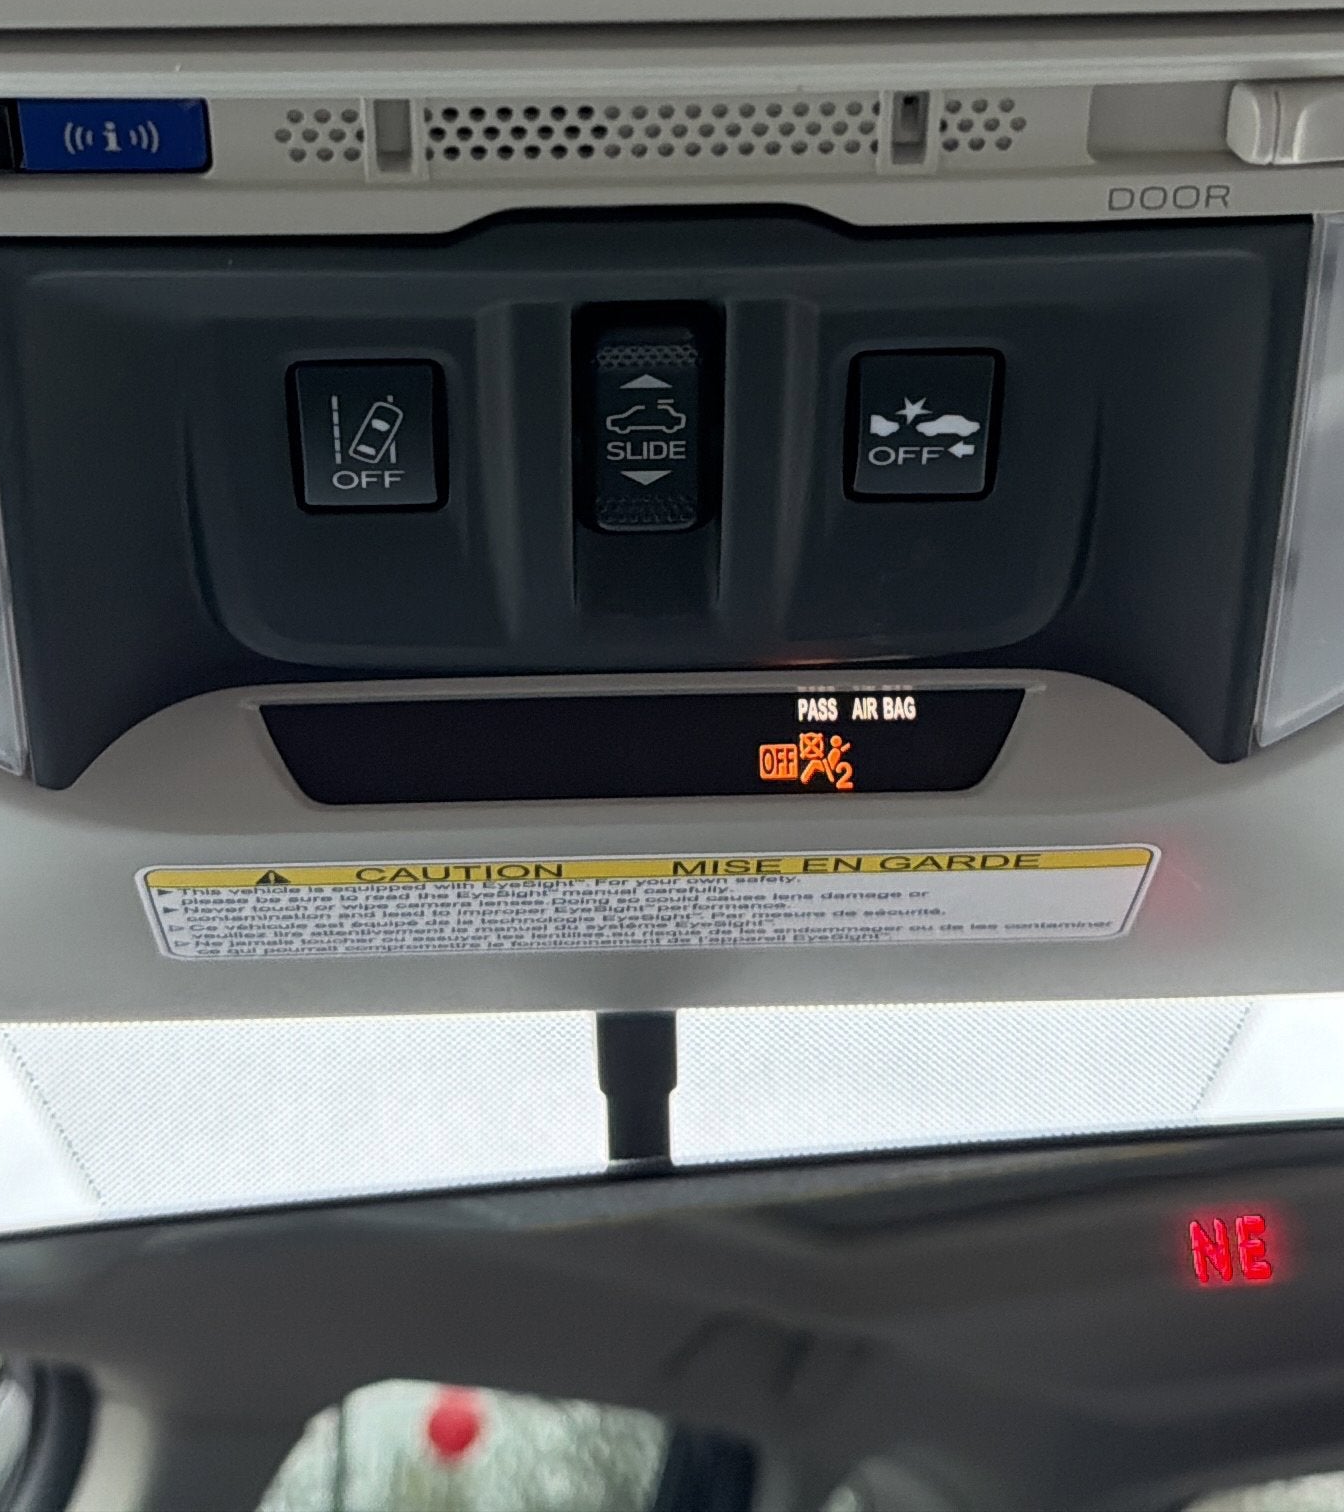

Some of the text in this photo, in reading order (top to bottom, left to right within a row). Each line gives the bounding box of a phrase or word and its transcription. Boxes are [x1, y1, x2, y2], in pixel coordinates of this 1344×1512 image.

[1107, 185, 1231, 211] DOOR
[607, 441, 686, 460] SLIDE
[868, 446, 944, 466] OFF
[332, 470, 405, 489] OFF
[798, 696, 916, 722] PASS AIR BAG
[762, 748, 795, 775] OFF
[355, 863, 562, 882] CAUTION
[672, 853, 1041, 876] MISE EN GARDE
[181, 887, 220, 895] This
[228, 886, 300, 894] vehicle
[331, 883, 425, 893] equipped
[636, 878, 681, 886] your
[181, 896, 248, 905] please
[562, 887, 636, 896] manual
[184, 905, 244, 913] Never
[253, 904, 307, 912] touch
[343, 902, 388, 910] wipe
[457, 907, 546, 916] improper
[1189, 1215, 1272, 1283] NE
